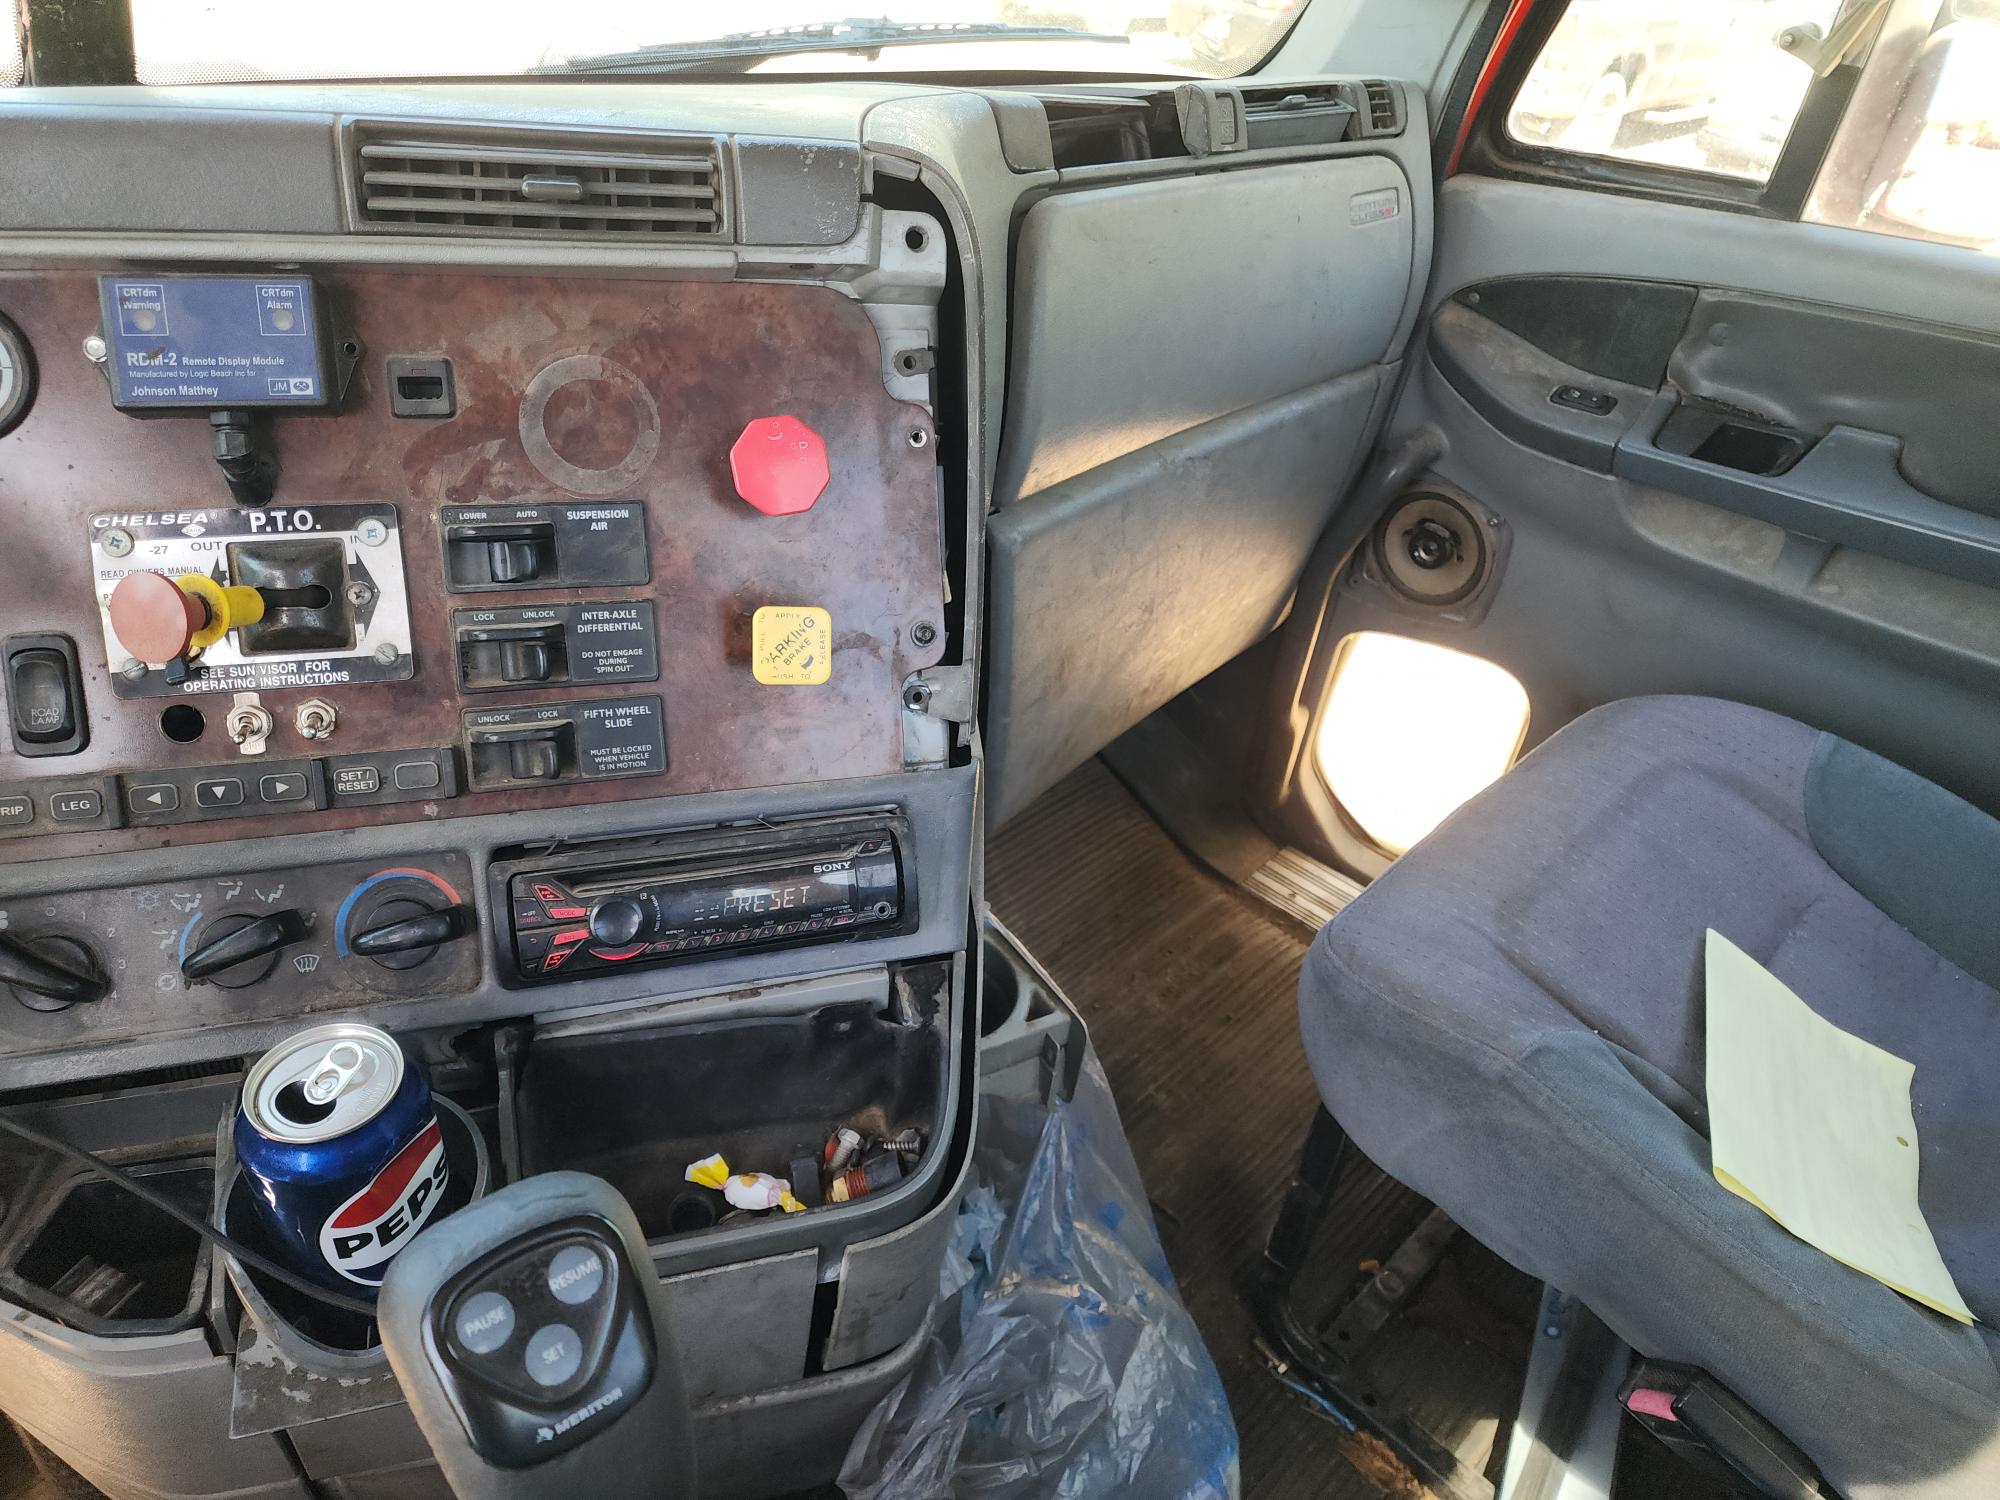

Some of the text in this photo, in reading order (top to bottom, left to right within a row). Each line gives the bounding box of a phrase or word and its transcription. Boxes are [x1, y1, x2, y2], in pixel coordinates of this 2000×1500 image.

[123, 288, 158, 297] CRTdm
[261, 288, 295, 297] CRTdm
[123, 300, 162, 312] Warning
[266, 301, 293, 310] Alarm
[182, 356, 217, 366] Remote
[219, 356, 252, 368] Display
[253, 356, 285, 366] Module
[128, 370, 178, 379] Manufactured
[179, 370, 189, 379] by
[131, 385, 219, 398] Johnson Matthey
[273, 382, 288, 392] JM
[459, 510, 538, 520] LOWER AUTO
[566, 509, 629, 521] SUSPENSION
[93, 510, 322, 533] CHELSEA P.T.O.
[590, 521, 608, 531] AIR
[190, 541, 223, 552] OUT
[100, 570, 125, 579] READ
[168, 565, 205, 576] MANUAL
[473, 610, 555, 622] LOCK UNLOCK
[581, 609, 637, 621] INTER-AXLE
[577, 621, 644, 634] DIFFERENTIAL
[582, 648, 644, 659] DO NOT ENGAGE
[783, 637, 812, 666] BRAKE
[598, 657, 628, 666] DURING
[200, 661, 331, 680] SEE SUN VISOR FOR
[183, 671, 350, 693] OPERATING INSTRUCTIONS
[31, 707, 59, 717] ROAD
[477, 710, 558, 723] UNLOCK LOCK
[584, 705, 652, 720] FIFTH WHEEL
[32, 715, 60, 725] LAMP
[604, 717, 633, 729] SLIDE
[590, 744, 652, 757] MUST BE LOCKED
[595, 752, 650, 763] WHEN VEHICLE
[598, 760, 647, 771] IS IN MOTION
[340, 771, 364, 781] SET
[337, 780, 375, 791] RESET
[0, 806, 24, 816] RIP
[61, 800, 91, 812] LEG
[813, 861, 852, 874] SONY
[723, 885, 811, 916] PRESET
[107, 927, 116, 938] 2
[118, 959, 127, 969] 3
[111, 990, 118, 1000] 4
[549, 1255, 601, 1293] RESUME
[464, 1305, 508, 1337] PAUSE
[541, 1342, 566, 1366] SET
